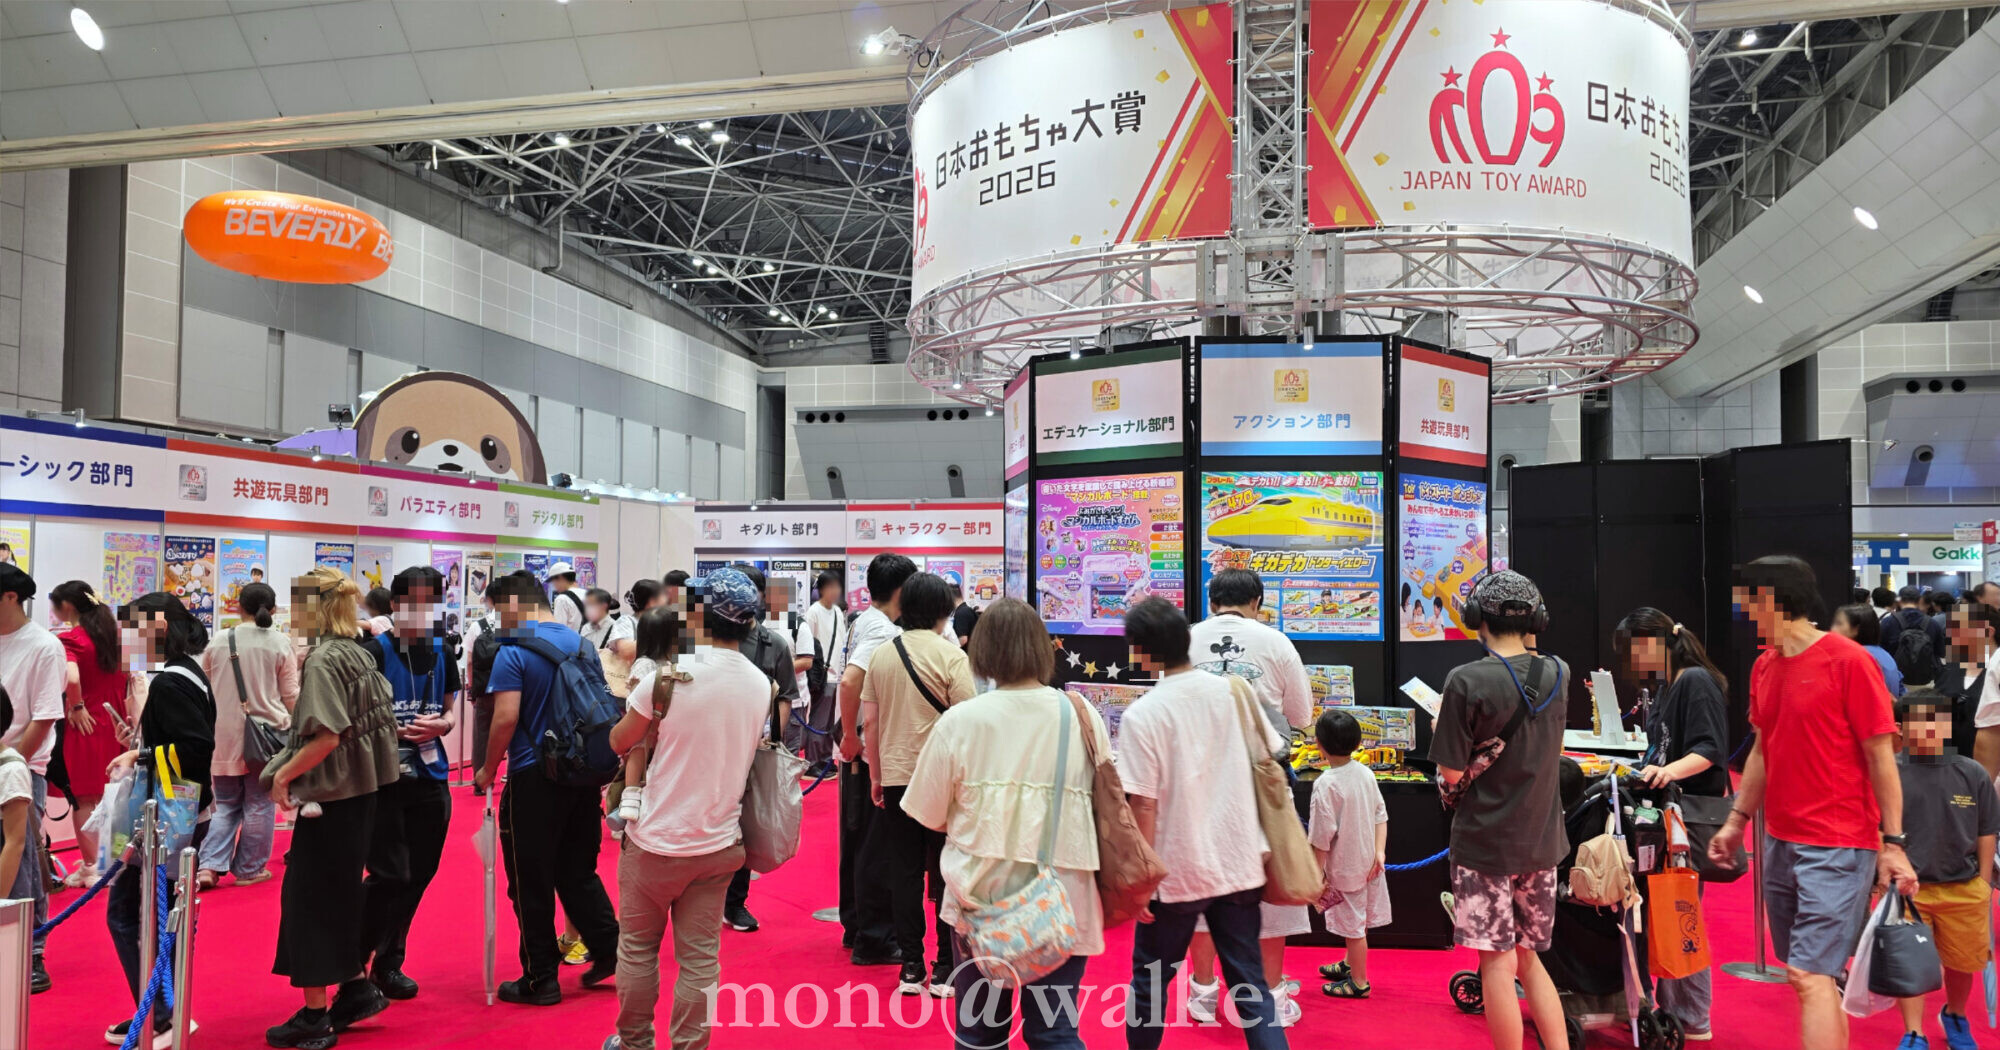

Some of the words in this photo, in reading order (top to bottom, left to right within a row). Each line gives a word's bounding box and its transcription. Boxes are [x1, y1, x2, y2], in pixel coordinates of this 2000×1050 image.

[1587, 81, 1688, 160] 日本おもち
[936, 90, 1146, 190] 日本おもちゃ大賞
[979, 160, 1056, 206] 2026
[1401, 171, 1471, 190] JAPAN
[1481, 171, 1522, 191] TOY
[1527, 173, 1587, 198] AWARD
[1650, 151, 1686, 199] 2026
[224, 208, 367, 249] BEVERLY
[1043, 416, 1175, 440] エデュケーショナル部門
[1233, 413, 1351, 429] アクション部門
[1420, 418, 1470, 441] 共遊玩具部門
[233, 477, 329, 506] 共遊玩具部門
[531, 510, 585, 530] デジタル部門
[739, 523, 819, 537] キダルト部門
[881, 522, 992, 536] キャラクター部門
[1932, 546, 1983, 561] Gakk
